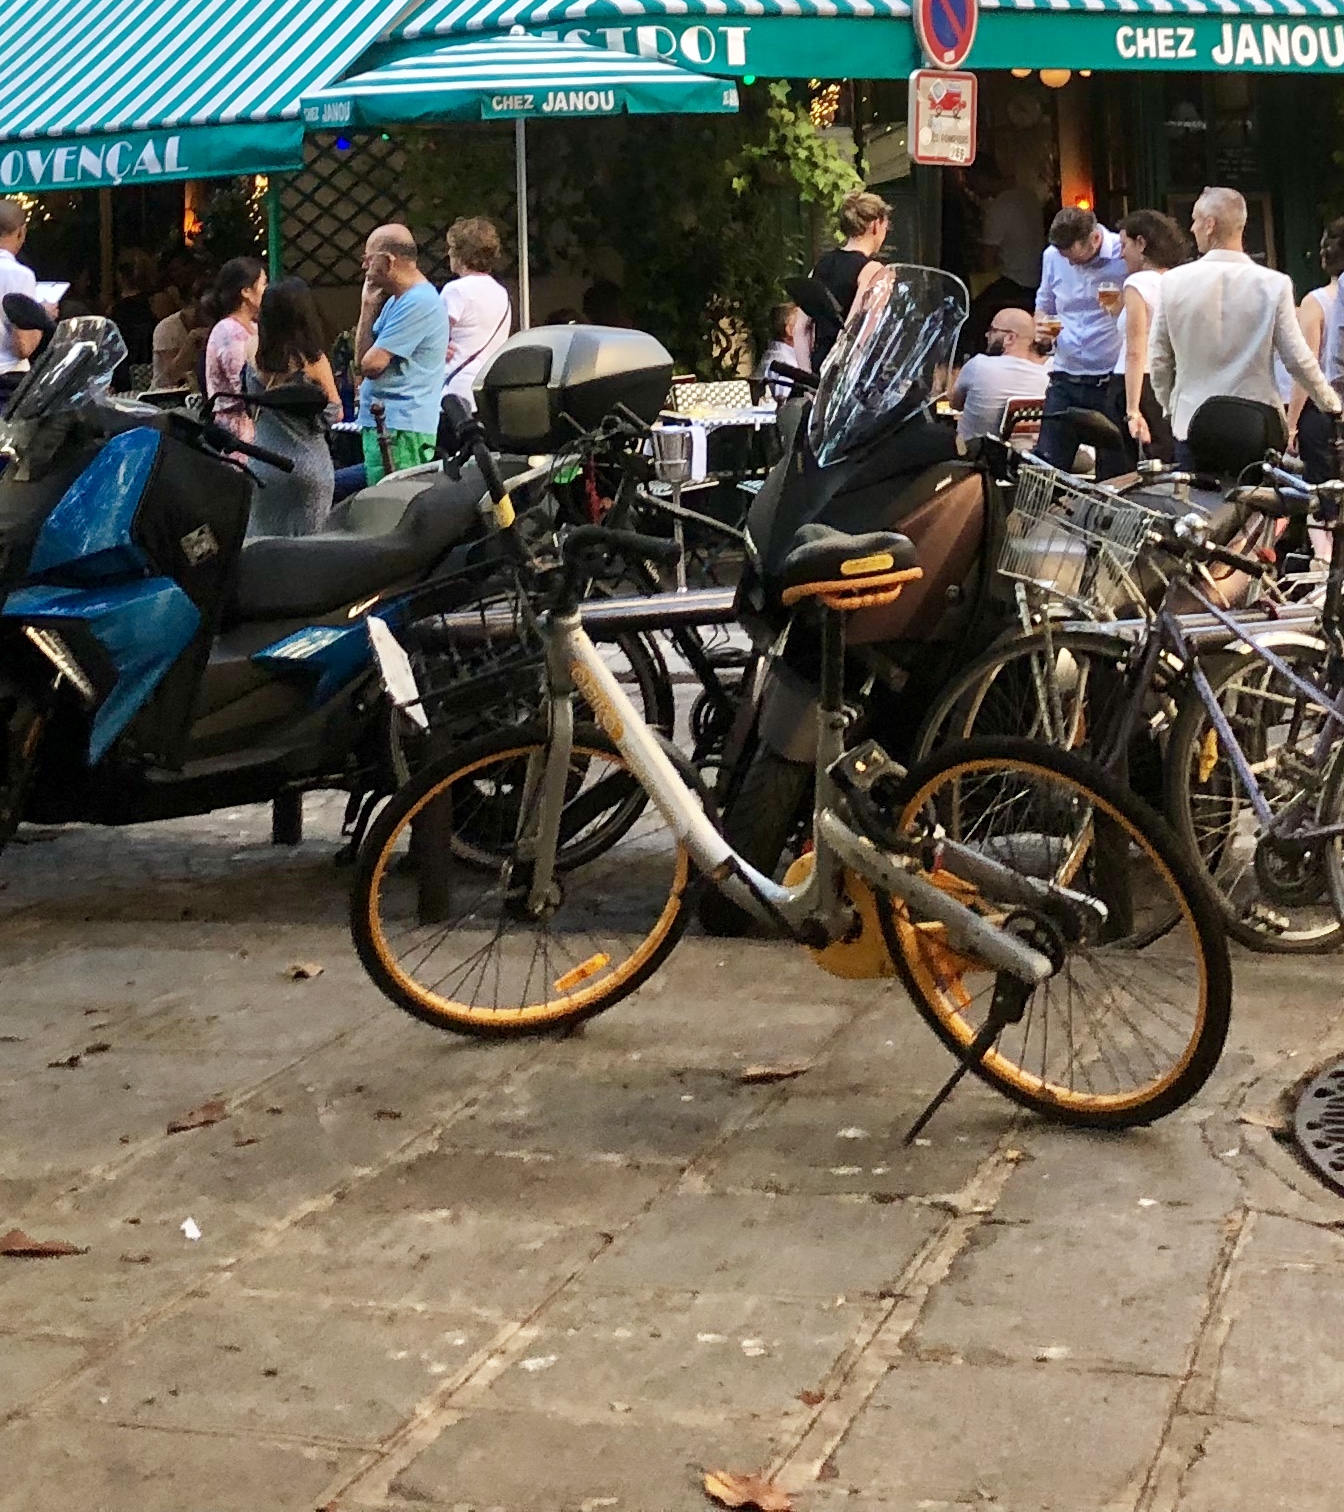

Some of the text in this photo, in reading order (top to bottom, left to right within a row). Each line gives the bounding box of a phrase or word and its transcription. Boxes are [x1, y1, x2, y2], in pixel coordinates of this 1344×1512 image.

[526, 25, 752, 67] TROT
[1115, 25, 1198, 60] CHEZ
[321, 100, 351, 123] JANOU
[491, 89, 616, 113] CHEZ JANOU
